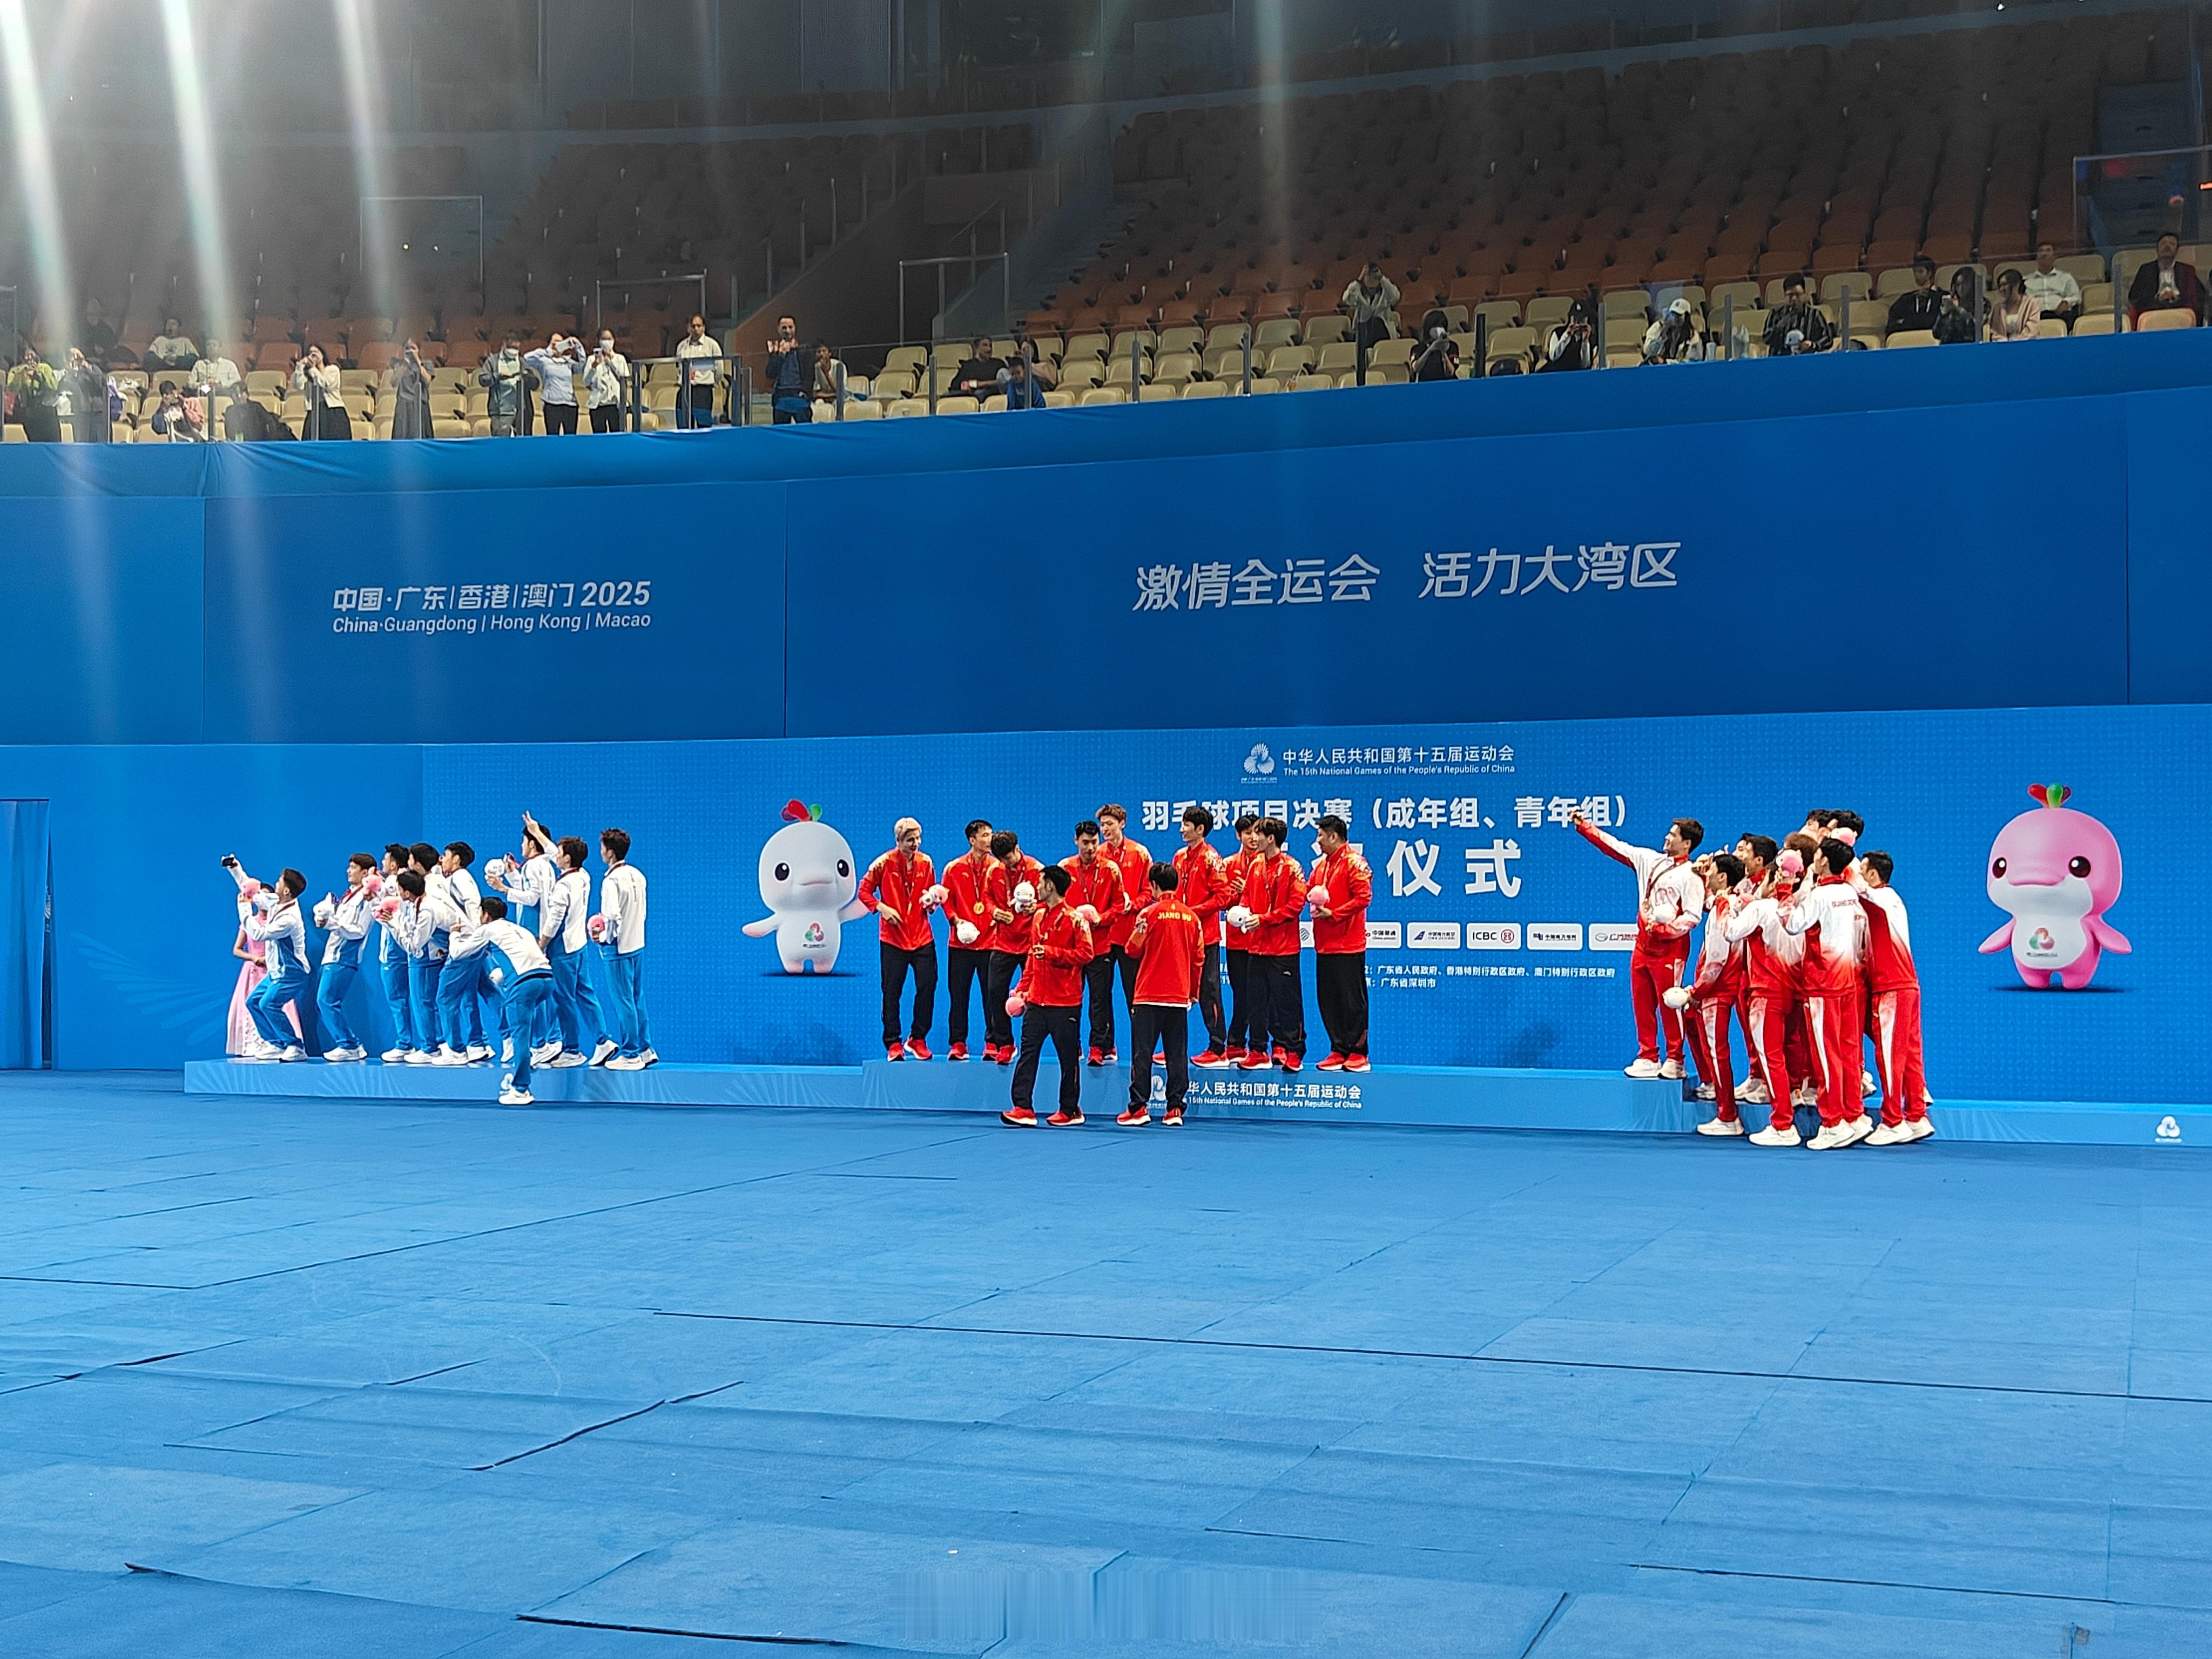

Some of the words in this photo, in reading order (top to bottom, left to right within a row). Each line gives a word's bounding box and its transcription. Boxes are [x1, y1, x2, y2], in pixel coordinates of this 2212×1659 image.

[1132, 554, 1380, 611] 激情全运会
[1418, 542, 1682, 598] 活力大湾区
[581, 581, 651, 606] 2025
[491, 614, 534, 633] Hong
[539, 613, 581, 631] Kong
[595, 612, 651, 628] Macao
[1283, 744, 1514, 765] 中华人民共和国第十五届运动会
[1284, 767, 1298, 775] The
[1300, 767, 1318, 775] 15th
[1319, 766, 1352, 775] National
[1354, 766, 1381, 774] Games
[1384, 766, 1392, 774] of
[1394, 765, 1407, 774] the
[1409, 765, 1442, 775] People's
[1444, 764, 1479, 775] Republic
[1481, 764, 1489, 773] of
[1492, 764, 1515, 773] China
[1473, 932, 1498, 940] ICBC
[1188, 1081, 1362, 1100] 华人民共和国第十五届运动会
[1204, 1097, 1231, 1105] National
[1276, 1099, 1303, 1108] People's
[1304, 1100, 1333, 1109] Republic
[1334, 1101, 1341, 1109] of
[1343, 1101, 1362, 1109] China
